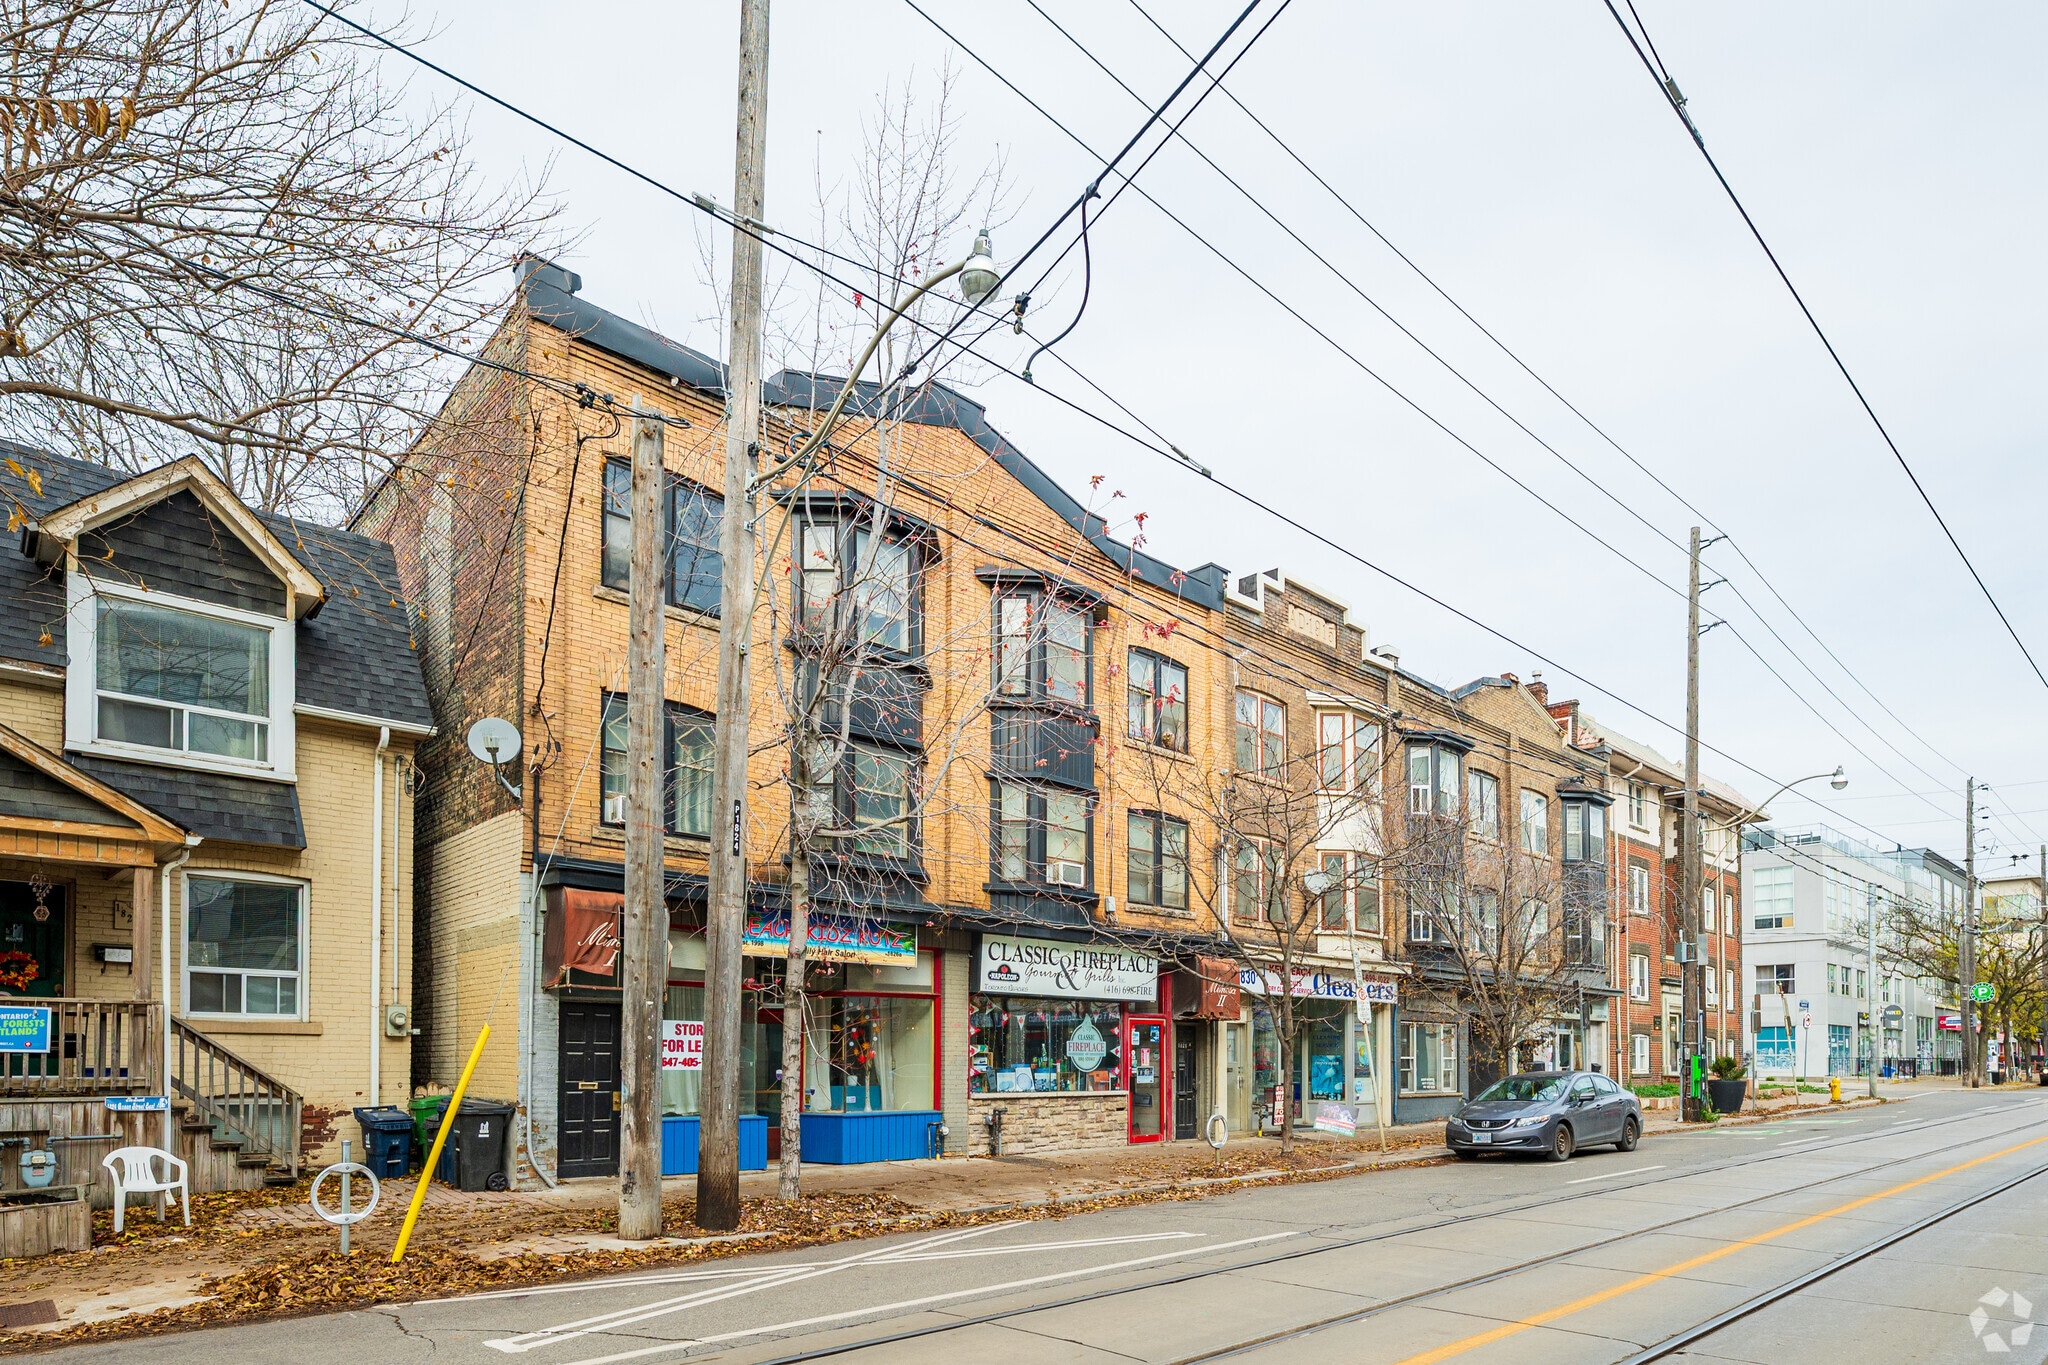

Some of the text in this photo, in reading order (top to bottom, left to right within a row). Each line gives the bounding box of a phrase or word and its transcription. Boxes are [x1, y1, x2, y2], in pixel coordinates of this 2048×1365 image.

[988, 941, 1154, 974] CLASSIC FIREPLACE
[1103, 984, 1121, 994] (416)
[1313, 972, 1395, 1001] Cleaers
[3, 1019, 46, 1028] FORESTS
[675, 1023, 704, 1036] STOR
[662, 1039, 684, 1053] FOR
[1068, 1041, 1105, 1052] FIREPLACE
